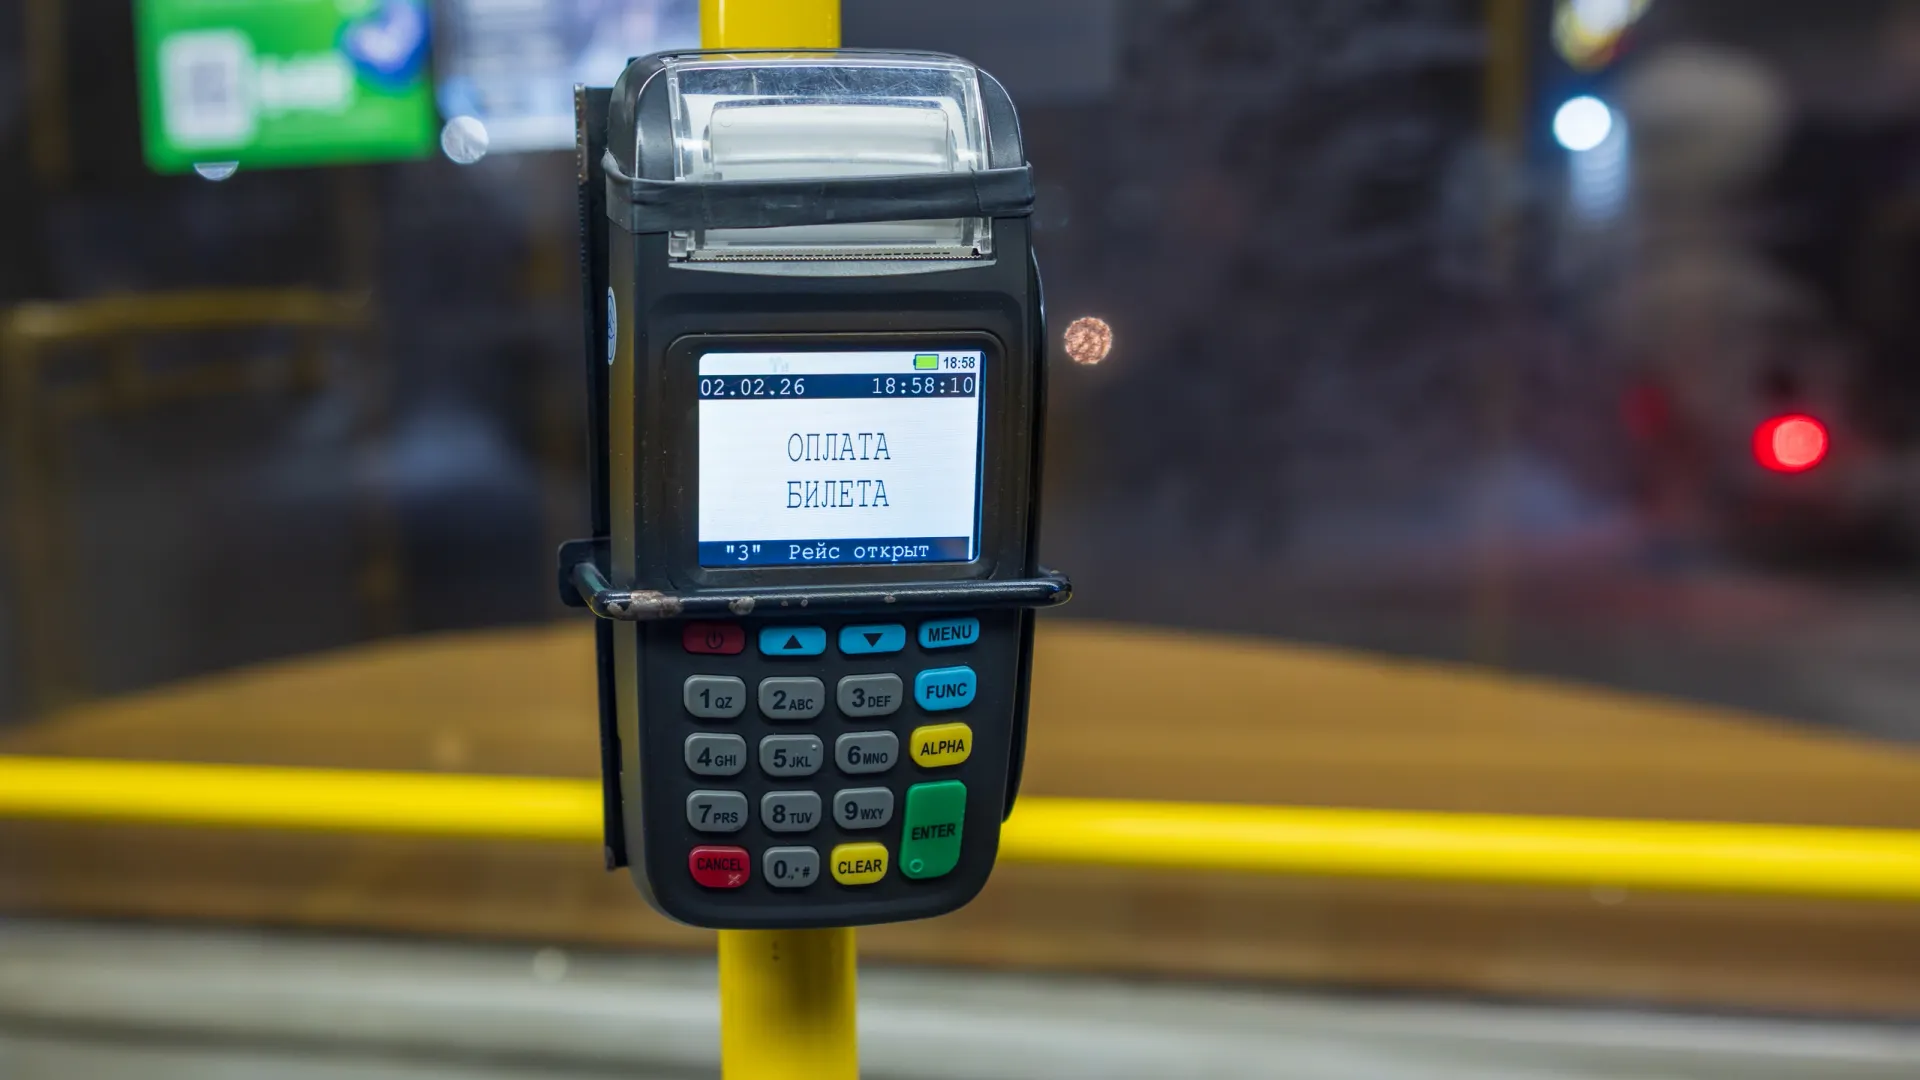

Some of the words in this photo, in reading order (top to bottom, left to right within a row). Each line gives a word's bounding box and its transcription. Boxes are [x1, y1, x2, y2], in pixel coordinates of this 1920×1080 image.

[943, 356, 976, 369] 18:58
[701, 378, 805, 396] 02.02.26
[872, 376, 974, 394] 18:58:10
[787, 433, 891, 462] ОПЛАТА
[786, 480, 890, 508] БИЛЕТА
[726, 544, 761, 561] "3"
[789, 542, 841, 560] Рейс
[853, 544, 930, 562] открыт
[928, 624, 972, 642] MENU
[926, 682, 967, 700] FUNC
[920, 738, 965, 756] ALPHA
[911, 822, 956, 840] ENTER
[697, 857, 743, 872] CANCEL
[838, 858, 882, 874] CLEAR
